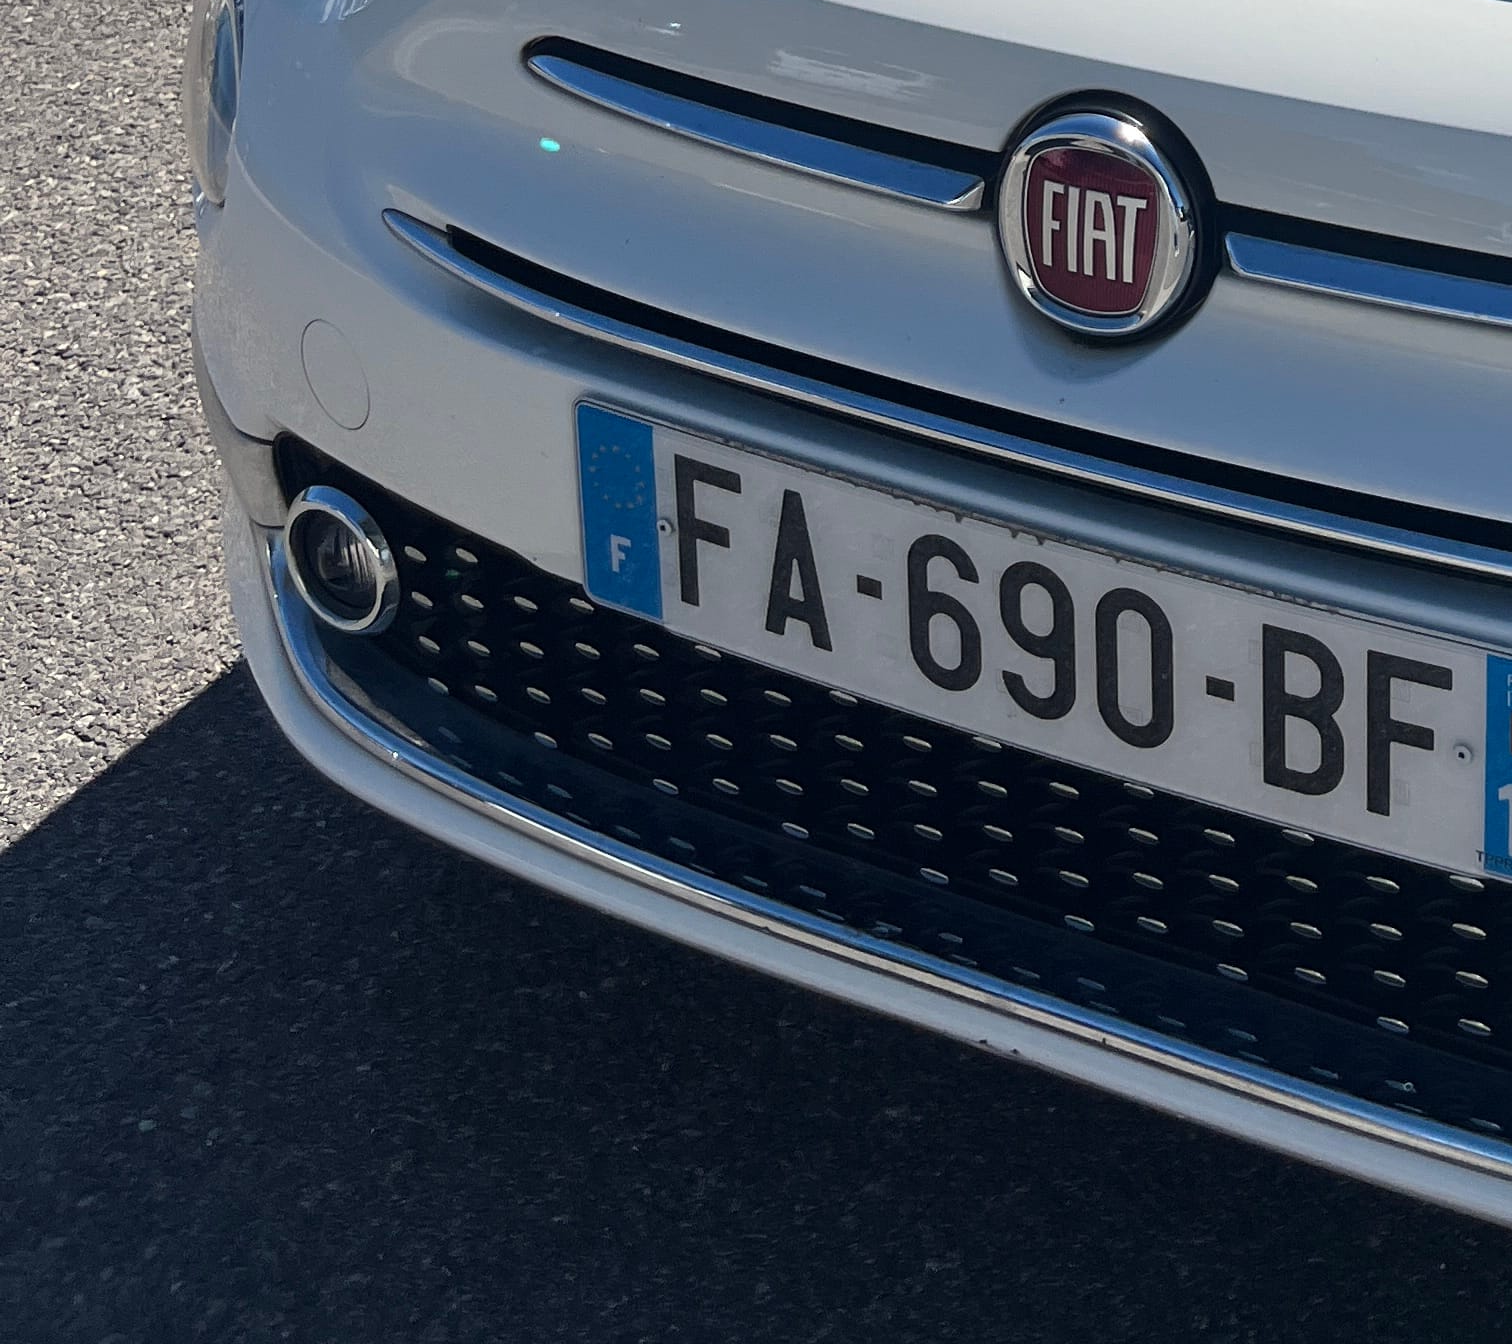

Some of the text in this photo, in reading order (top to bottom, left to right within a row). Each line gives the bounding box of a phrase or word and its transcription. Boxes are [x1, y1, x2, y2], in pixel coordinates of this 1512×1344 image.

[1043, 180, 1147, 283] FIAT
[610, 534, 632, 573] F
[674, 453, 1453, 817] FA-690-BF
